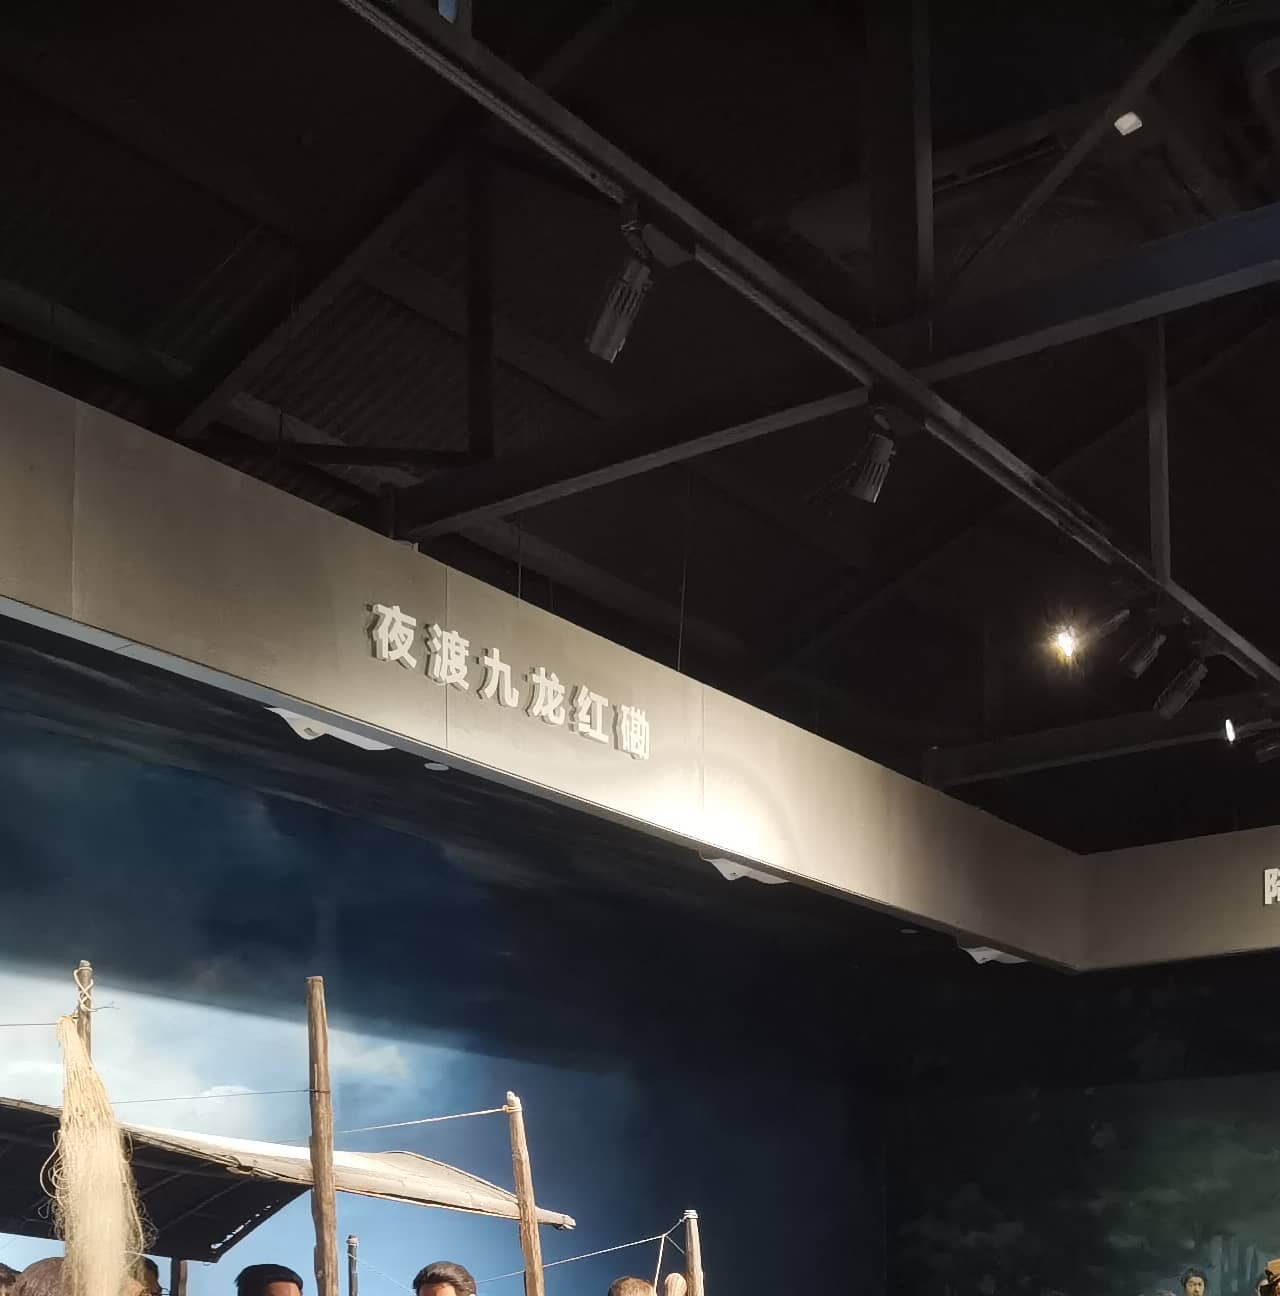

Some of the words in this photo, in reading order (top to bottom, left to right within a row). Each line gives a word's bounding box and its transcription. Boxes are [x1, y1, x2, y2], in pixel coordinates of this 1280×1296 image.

[369, 603, 651, 760] 夜渡九龙红磡
